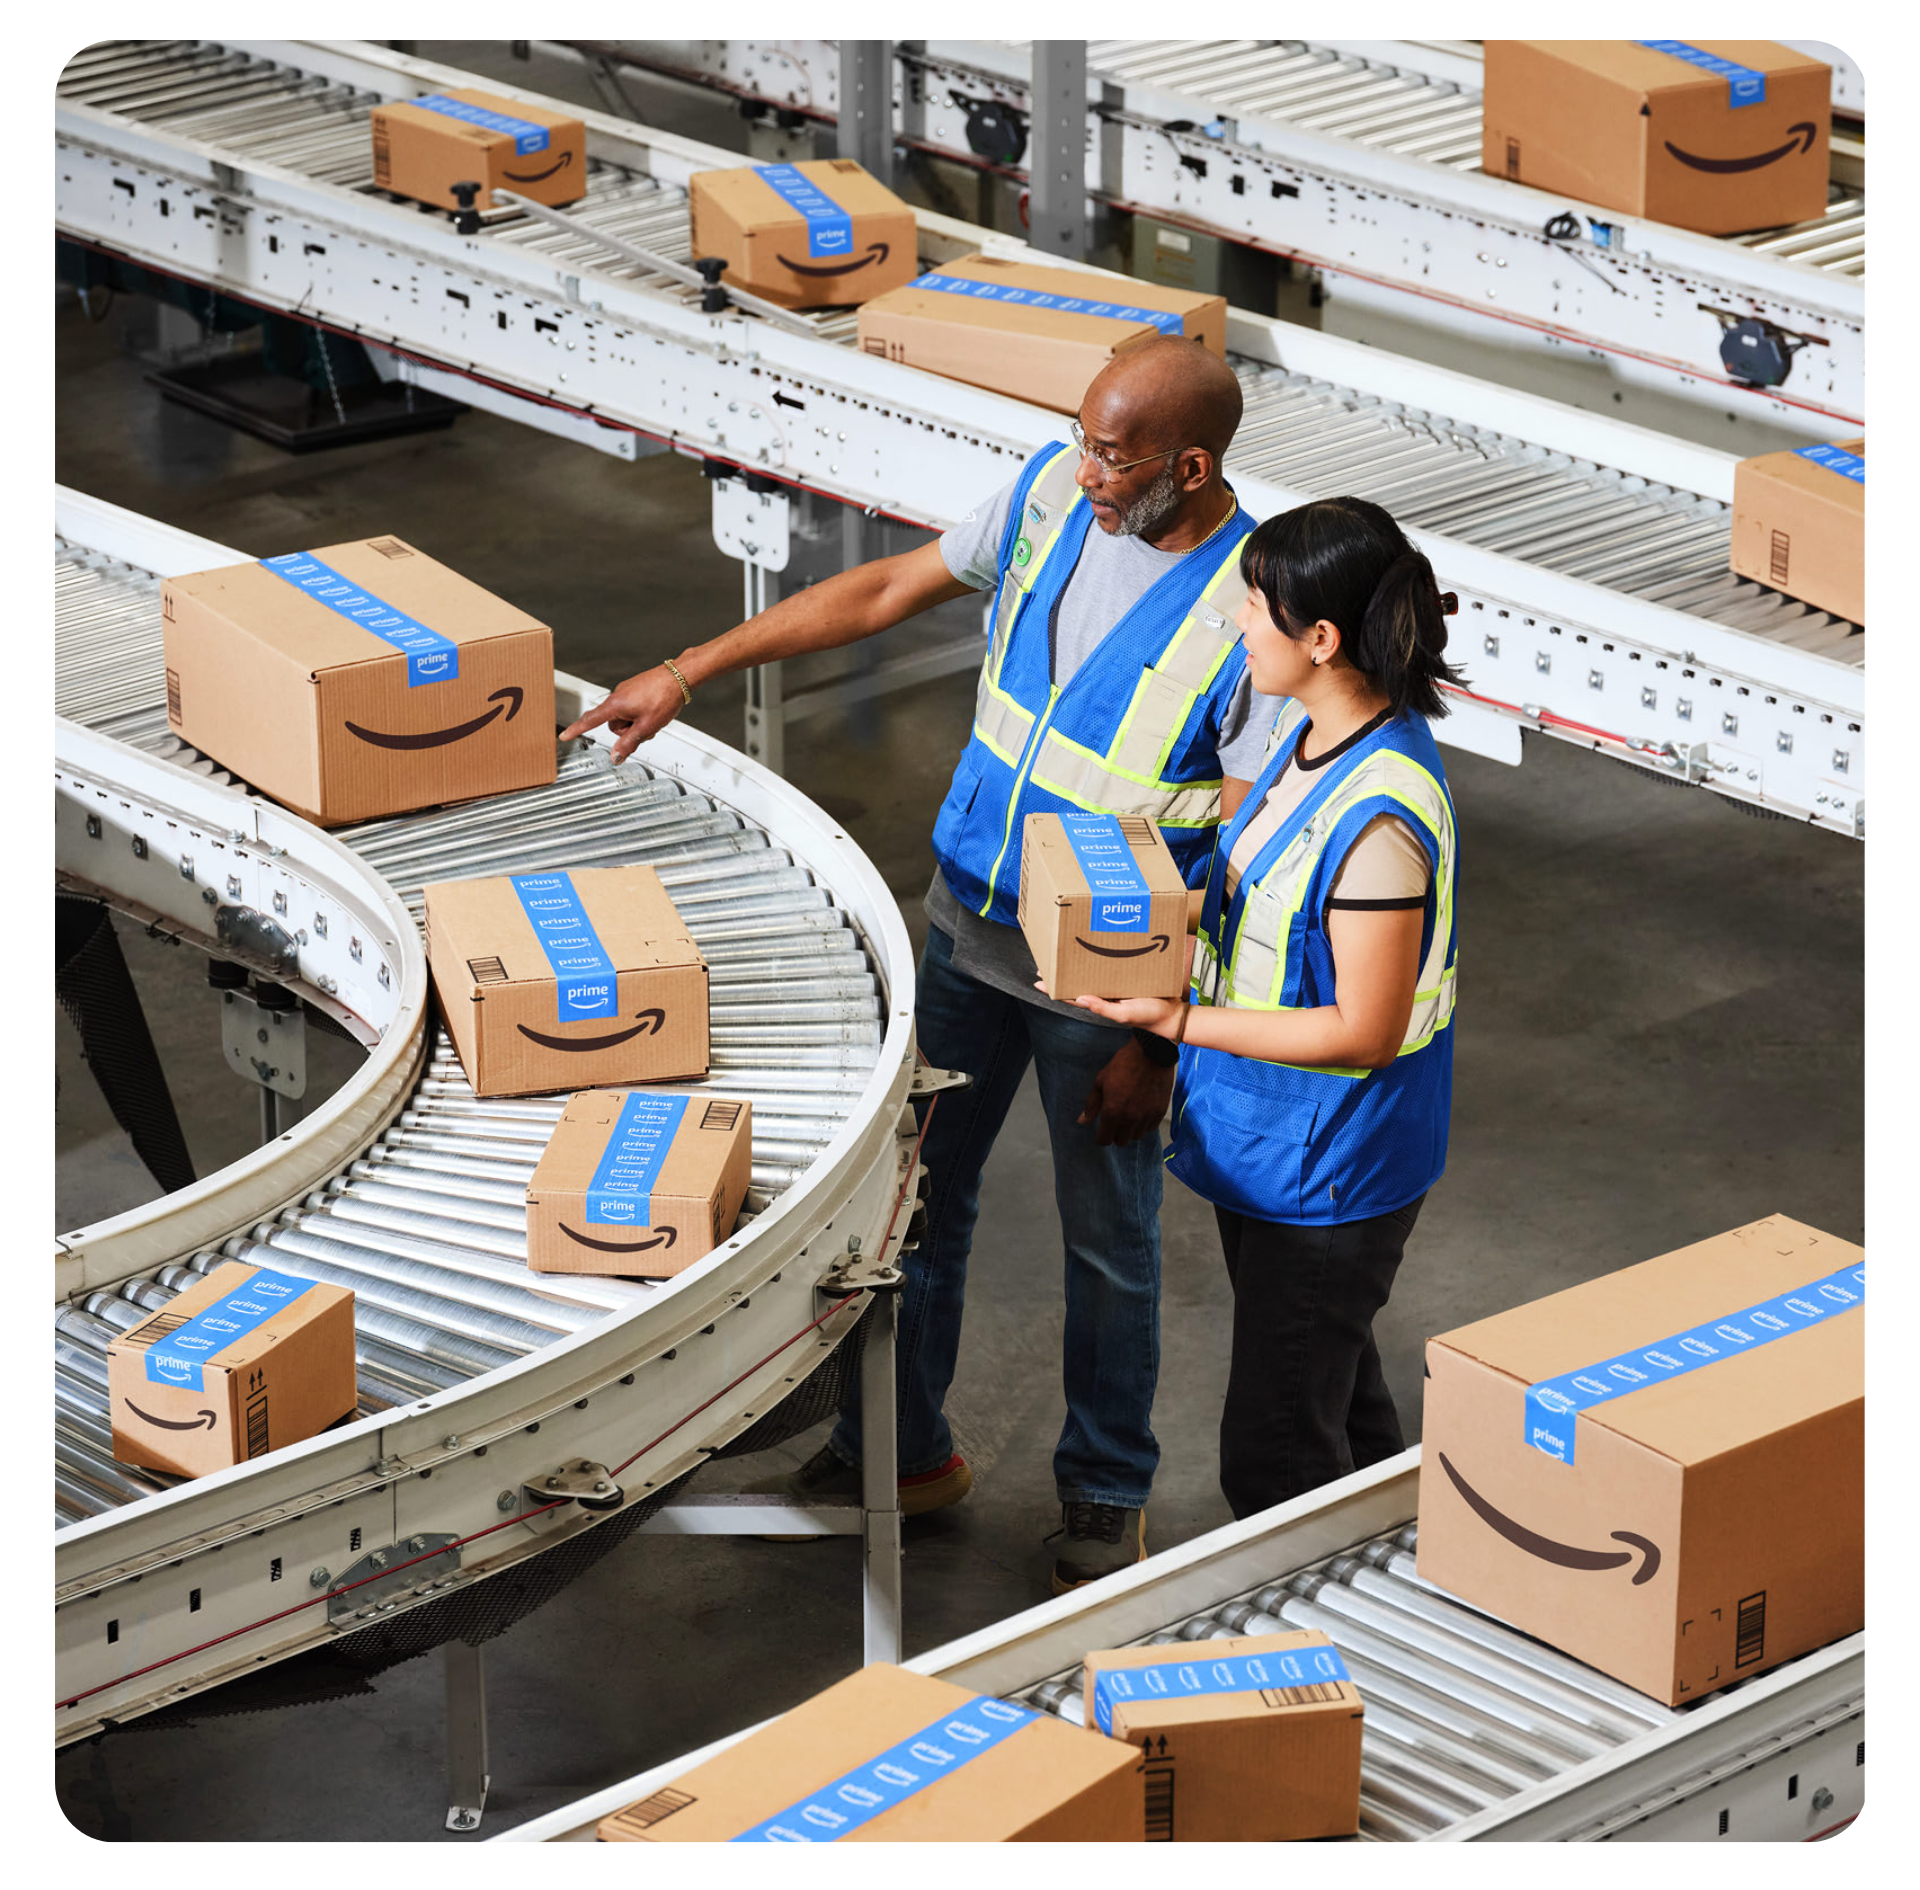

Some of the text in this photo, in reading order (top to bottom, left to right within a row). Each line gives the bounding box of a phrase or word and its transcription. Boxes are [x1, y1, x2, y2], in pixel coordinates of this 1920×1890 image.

[816, 229, 846, 241] prime
[417, 653, 448, 668] prime
[520, 879, 560, 888] prime
[529, 898, 570, 907] prime
[1102, 902, 1142, 916] prime
[539, 917, 579, 927] prime
[548, 937, 589, 946] prime
[558, 957, 599, 966] prime
[567, 984, 609, 1001] prime
[600, 1200, 635, 1211] prime
[254, 1281, 293, 1294] prime
[1821, 1284, 1858, 1300] prime
[228, 1299, 267, 1312] prime
[1786, 1297, 1824, 1314] prime
[202, 1317, 241, 1329] prime
[1752, 1311, 1790, 1328] prime
[1717, 1324, 1755, 1341] prime
[175, 1335, 216, 1347] prime
[1681, 1337, 1719, 1354] prime
[155, 1355, 190, 1371] prime
[1646, 1350, 1684, 1367] prime
[1610, 1363, 1648, 1379] prime
[1574, 1375, 1612, 1393] prime
[1538, 1387, 1576, 1406] prime
[1533, 1427, 1565, 1451] prime
